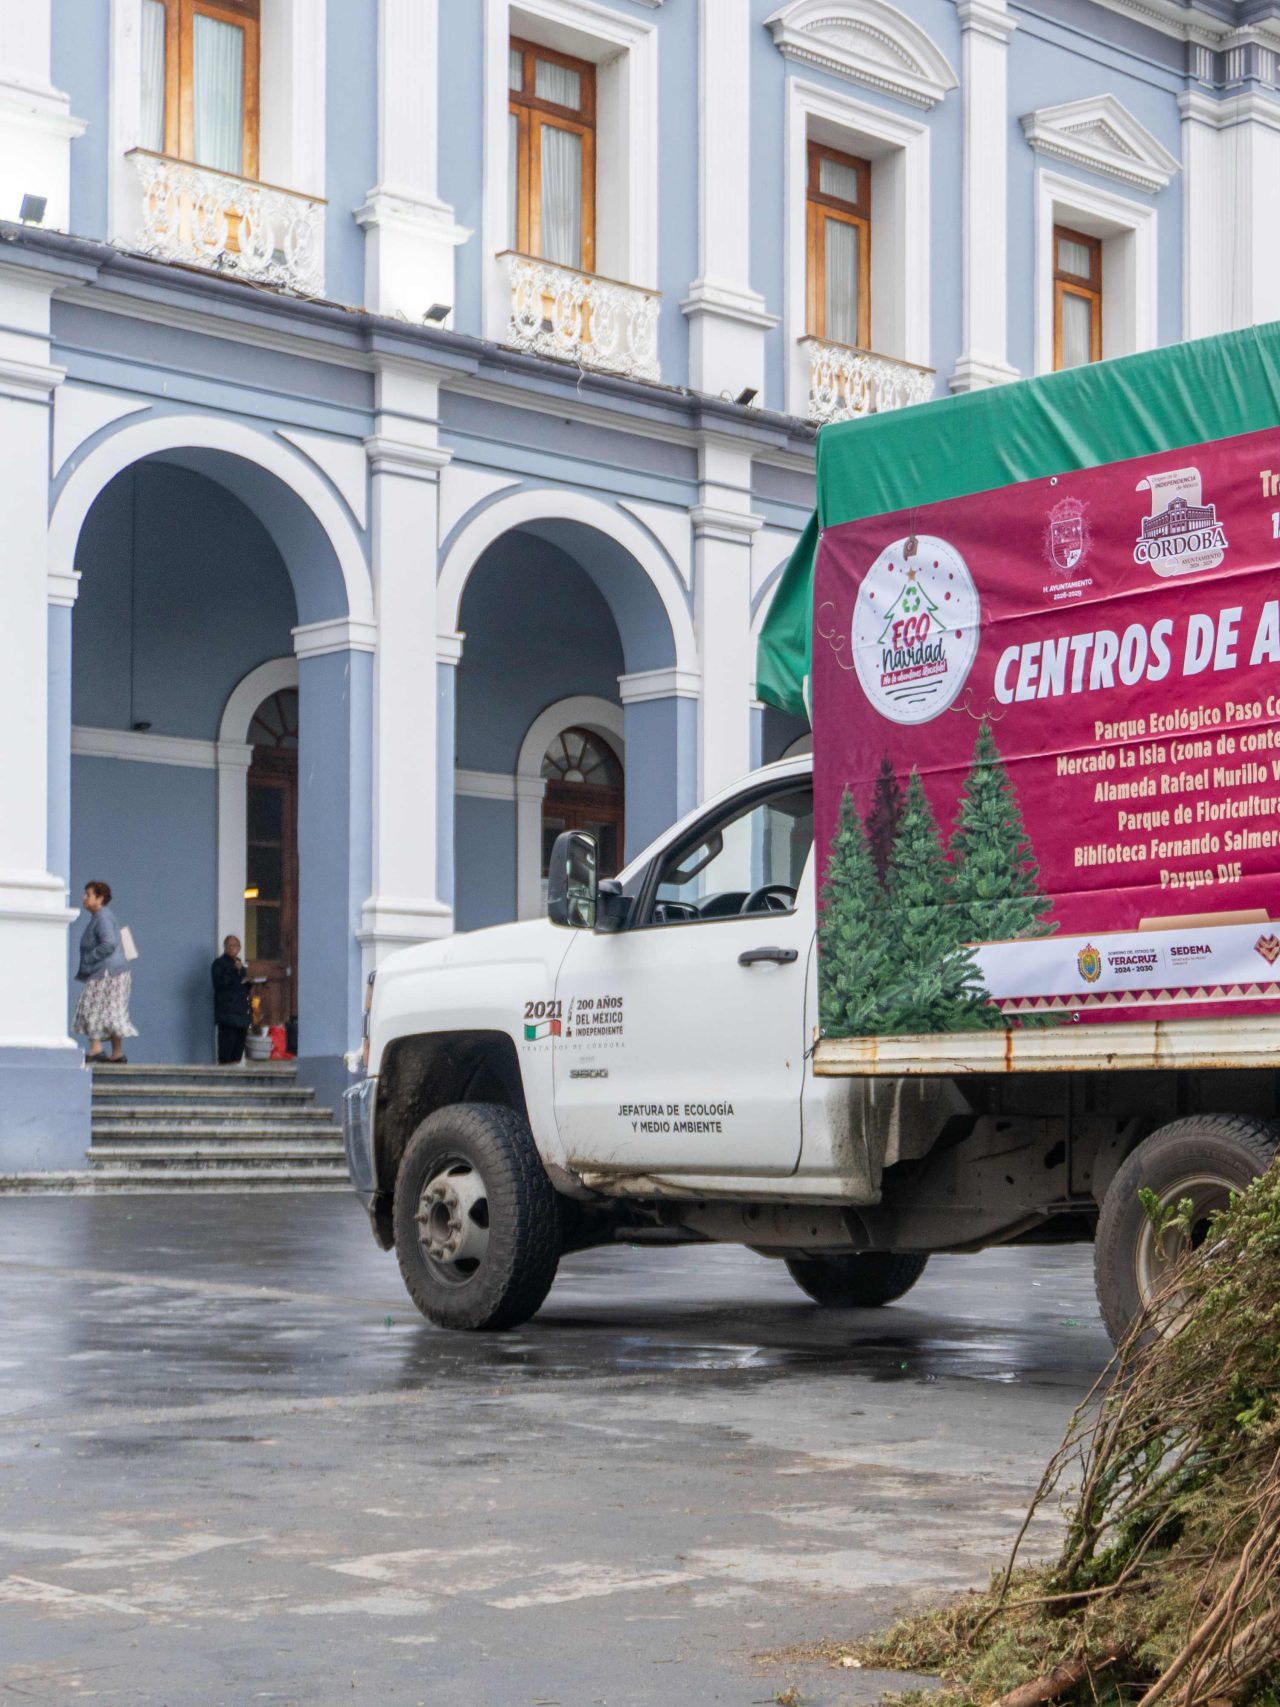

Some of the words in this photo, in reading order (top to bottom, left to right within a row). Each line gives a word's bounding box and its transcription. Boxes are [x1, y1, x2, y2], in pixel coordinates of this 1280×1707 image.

[1049, 579, 1092, 592] AYUNTAMIENTO
[892, 613, 930, 651] ECO
[993, 618, 1174, 705] CENTROS
[1182, 606, 1243, 676] DE
[1095, 718, 1146, 742] Parque
[1150, 705, 1221, 734] Ecológico
[1225, 700, 1262, 724] Paso
[1056, 751, 1116, 776] Mercado
[1119, 748, 1136, 768] La
[1139, 744, 1166, 767] Isla
[1170, 740, 1212, 764] (zona
[1216, 734, 1235, 755] de
[1094, 775, 1157, 803] Alameda
[1160, 769, 1209, 795] Rafael
[1213, 761, 1267, 789] Murillo
[1118, 810, 1170, 832] Parque
[1174, 804, 1192, 824] de
[1074, 841, 1147, 867] Biblioteca
[1150, 832, 1220, 859] Fernando
[1160, 868, 1214, 890] Parque
[1217, 862, 1242, 884] DIF
[1170, 944, 1212, 956] SEDEMA
[1108, 954, 1158, 966] VERACRUZ
[1114, 966, 1132, 974] 2024
[1136, 965, 1153, 973] 2030
[524, 1001, 562, 1019] 2021
[576, 999, 594, 1010] 200
[596, 995, 623, 1009] AÑOS
[576, 1014, 590, 1025] DEL
[592, 1010, 623, 1024] MÉXICO
[576, 1026, 623, 1037] INDEPENDIENTE
[618, 1104, 664, 1116] JEFATURA
[667, 1104, 679, 1115] DE
[684, 1101, 734, 1116] ECOLOGÍA
[632, 1122, 638, 1132] Y
[641, 1121, 670, 1132] MEDIO
[673, 1121, 722, 1132] AMBIENTE
